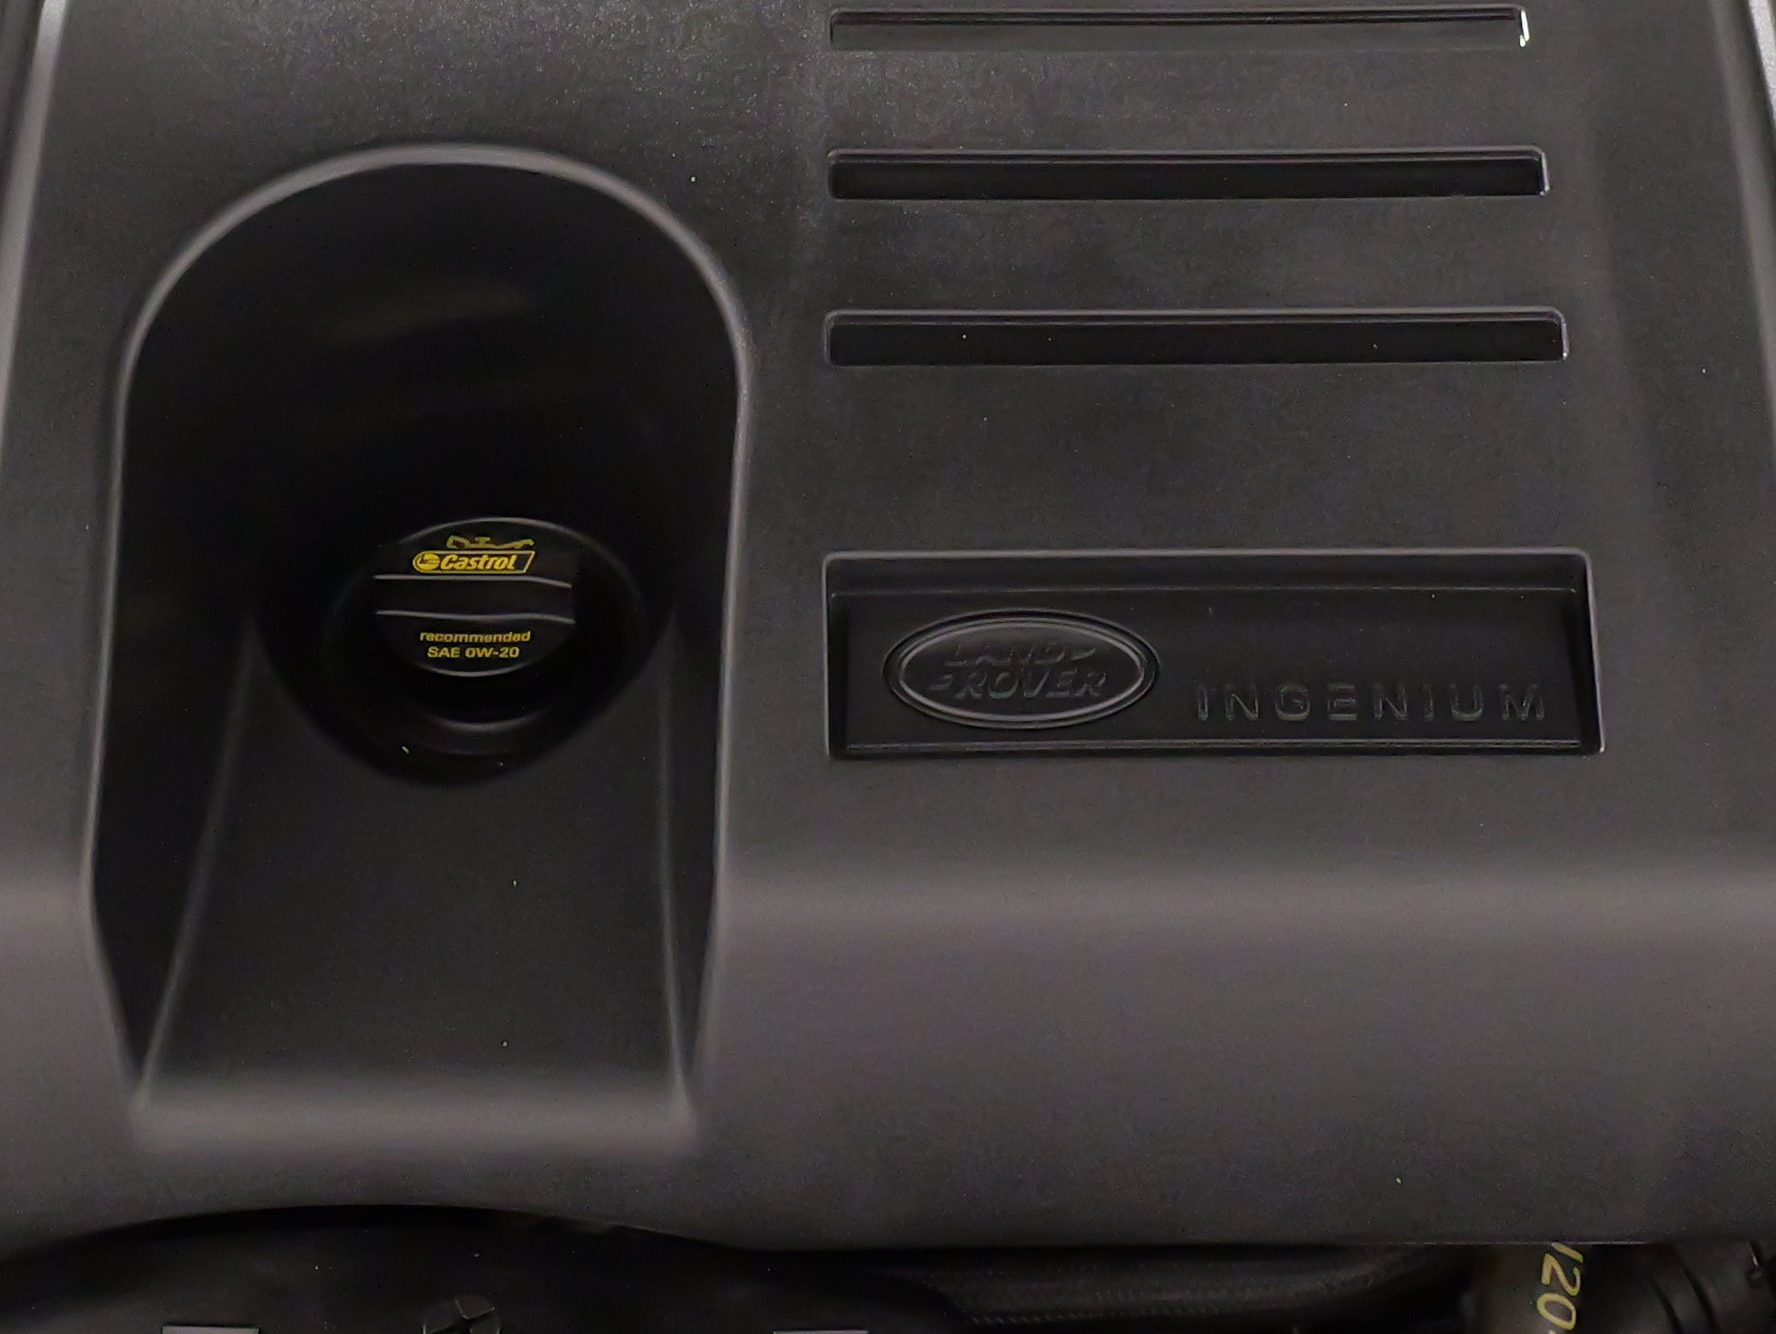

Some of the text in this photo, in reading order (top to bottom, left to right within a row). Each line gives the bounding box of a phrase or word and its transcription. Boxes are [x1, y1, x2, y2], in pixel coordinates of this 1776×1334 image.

[440, 553, 518, 571] Castrol
[419, 630, 531, 644] recommended
[427, 647, 520, 659] SAE 0W-20
[1196, 682, 1547, 723] INGENIUM
